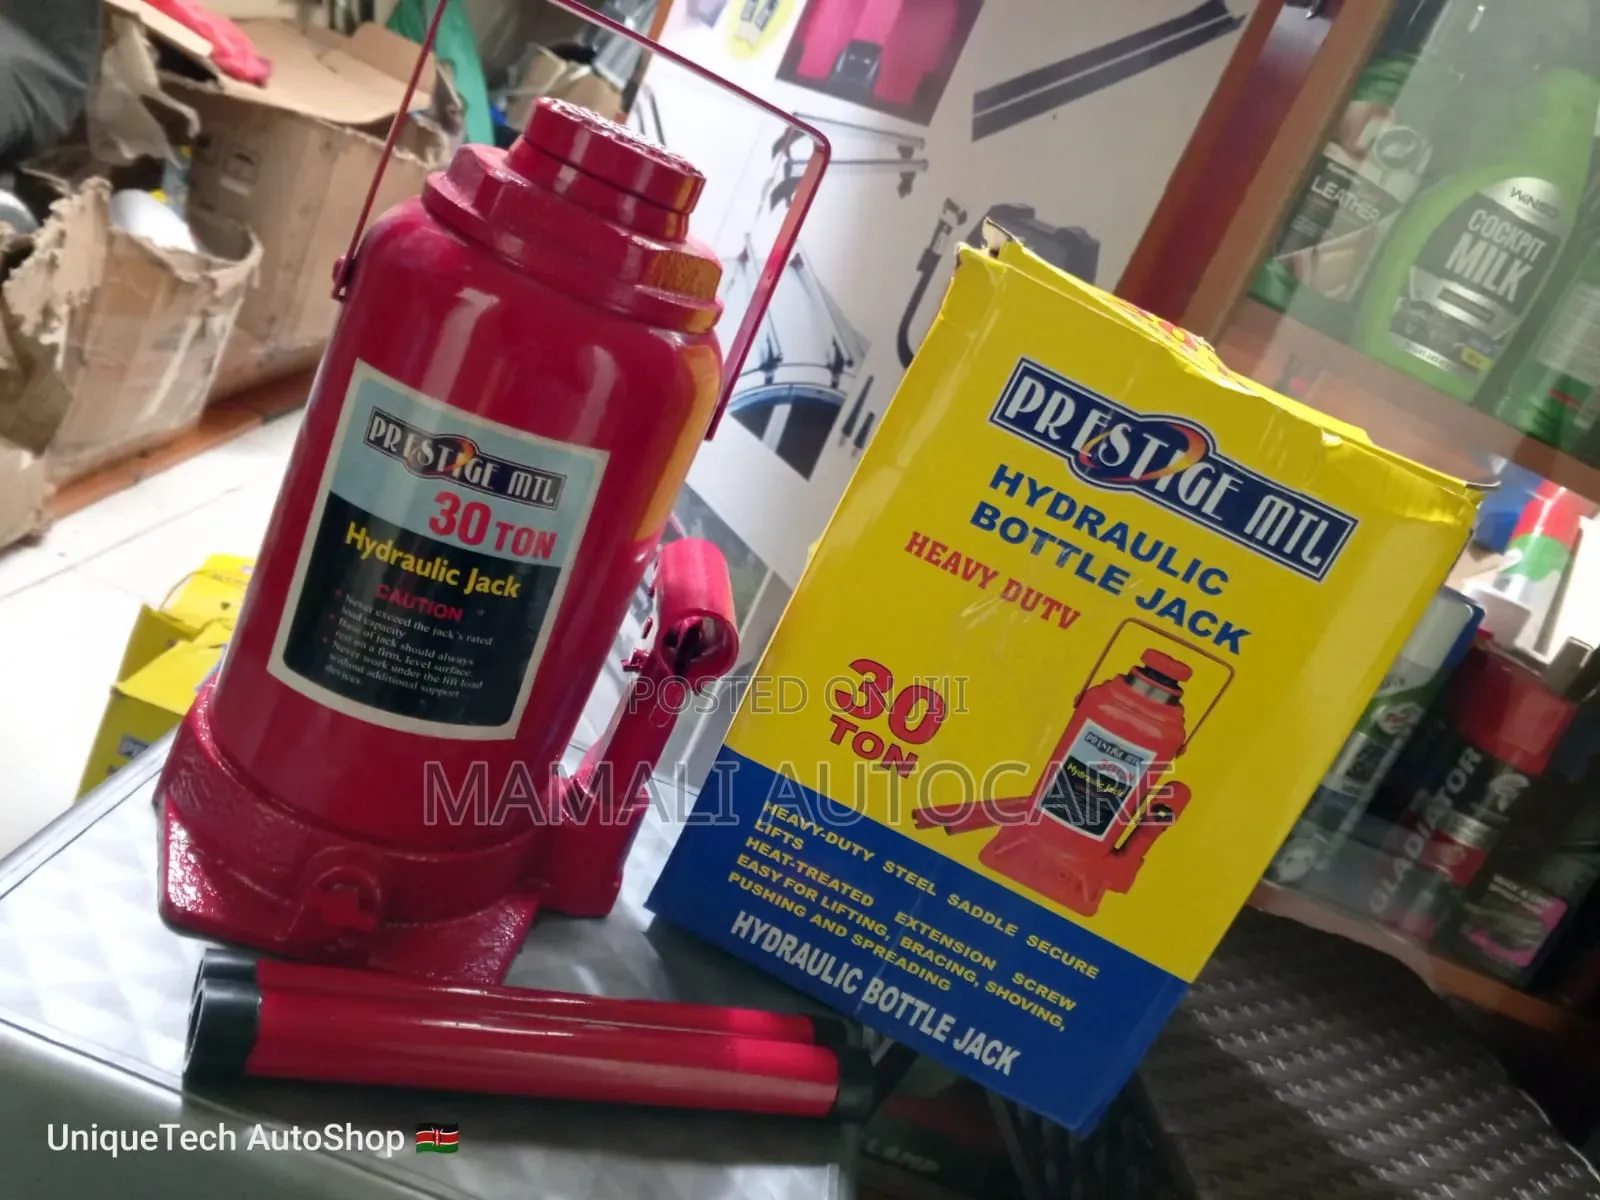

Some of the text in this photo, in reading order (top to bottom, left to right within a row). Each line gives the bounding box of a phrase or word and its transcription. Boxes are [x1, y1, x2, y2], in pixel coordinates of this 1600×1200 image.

[1444, 233, 1533, 303] MILK
[1467, 209, 1547, 262] COCKPIT
[368, 416, 554, 504] PRESTIGE MTL
[1004, 375, 1331, 568] PRESTIGE MTL
[345, 521, 521, 598] Hydraulic Jack
[429, 491, 557, 560] 30 TON
[904, 531, 999, 590] HEAVY
[989, 464, 1229, 595] HYDRAULIC
[376, 584, 464, 622] CAUTION
[970, 501, 1251, 655] BOTTLE JACK
[354, 639, 367, 650] on
[405, 655, 432, 669] level
[362, 614, 406, 640] capacity
[376, 608, 412, 628] exceed
[413, 621, 430, 633] the
[466, 633, 493, 646] rated
[376, 634, 397, 649] jack
[400, 643, 435, 658] should
[438, 652, 475, 667] always
[332, 641, 360, 659] Never
[363, 655, 389, 670] work
[391, 664, 422, 679] under
[423, 671, 441, 683] the
[460, 678, 484, 690] load
[366, 668, 418, 690] additional
[834, 658, 946, 745] 30
[829, 714, 918, 779] TON
[754, 819, 804, 850] LIFTS
[1369, 746, 1482, 914] GLADIATOR
[746, 836, 1077, 1012] HEAT-TREATED EXTENSION SCREW
[764, 801, 1100, 980] HEAVY-DUTY STEEL SADDLE SECURE
[728, 871, 952, 991] PUSHING AND SPREADING
[736, 853, 1066, 1032] EASY FOR LIFTING, BRACING, SHOVING,
[730, 910, 1022, 1075] HYDRAULIC BOTTLE JACK
